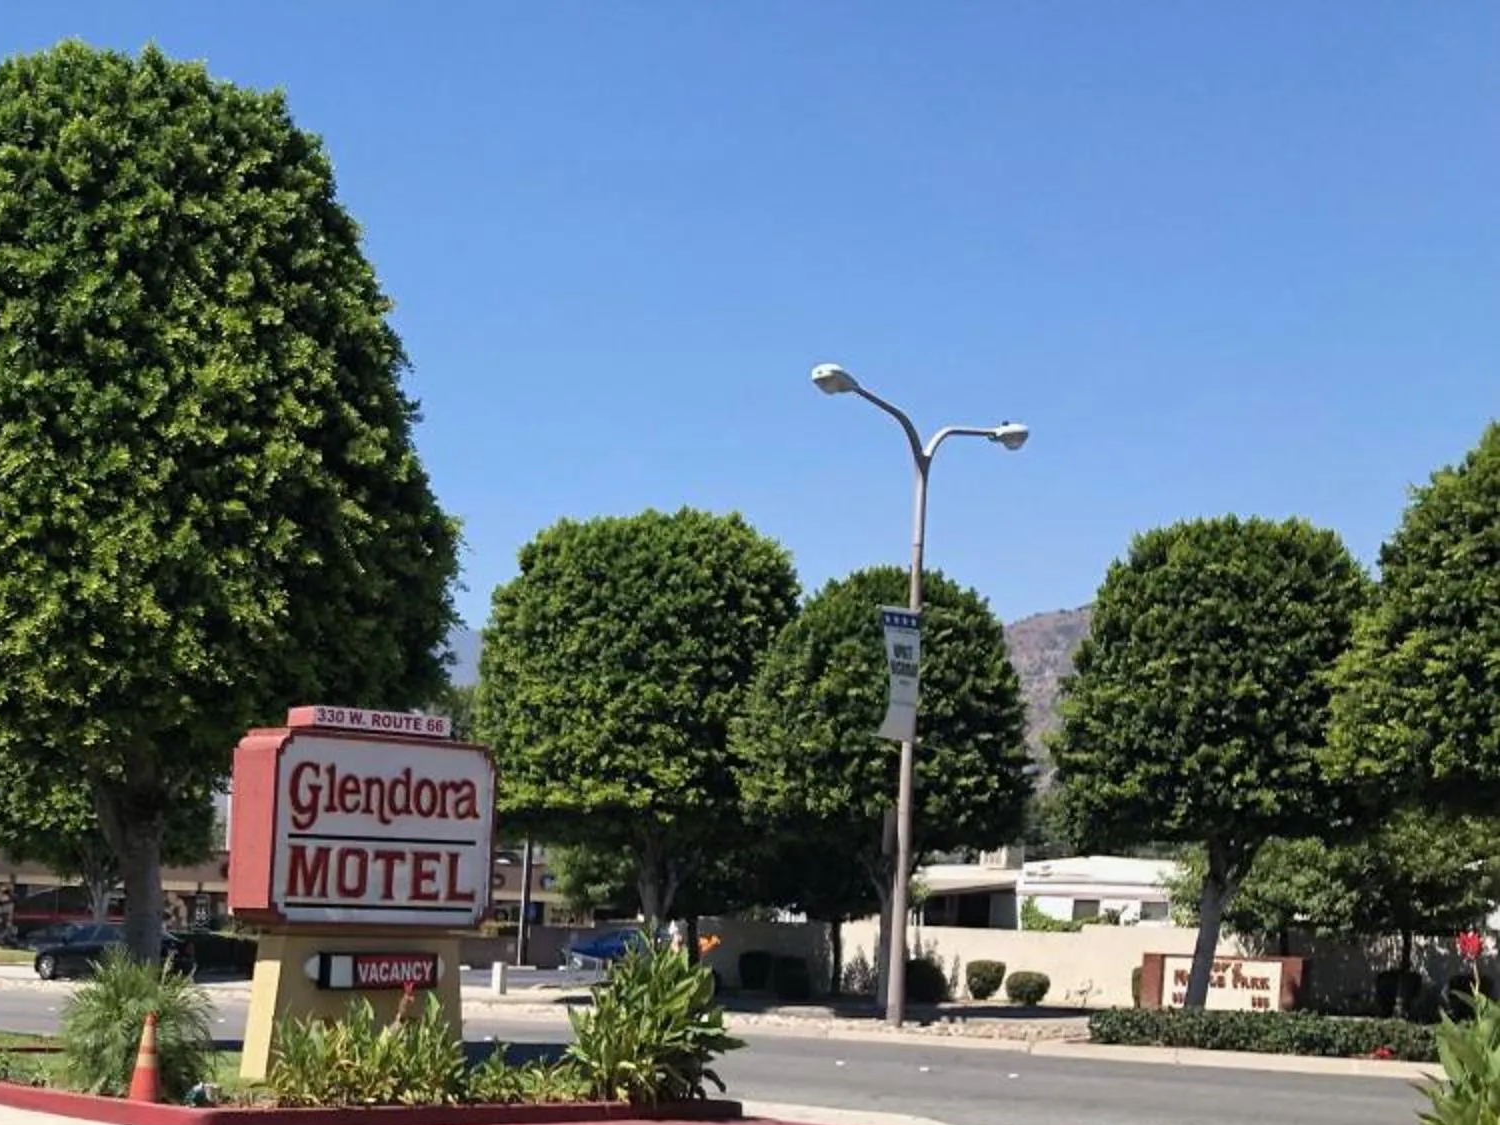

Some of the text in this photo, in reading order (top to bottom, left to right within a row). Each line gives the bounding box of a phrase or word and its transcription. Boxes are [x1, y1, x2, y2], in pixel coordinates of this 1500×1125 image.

[317, 707, 445, 733] 330 W. ROUTE 66
[289, 761, 480, 830] Glendora
[285, 844, 476, 902] MOTEL
[357, 961, 433, 983] VACANCY
